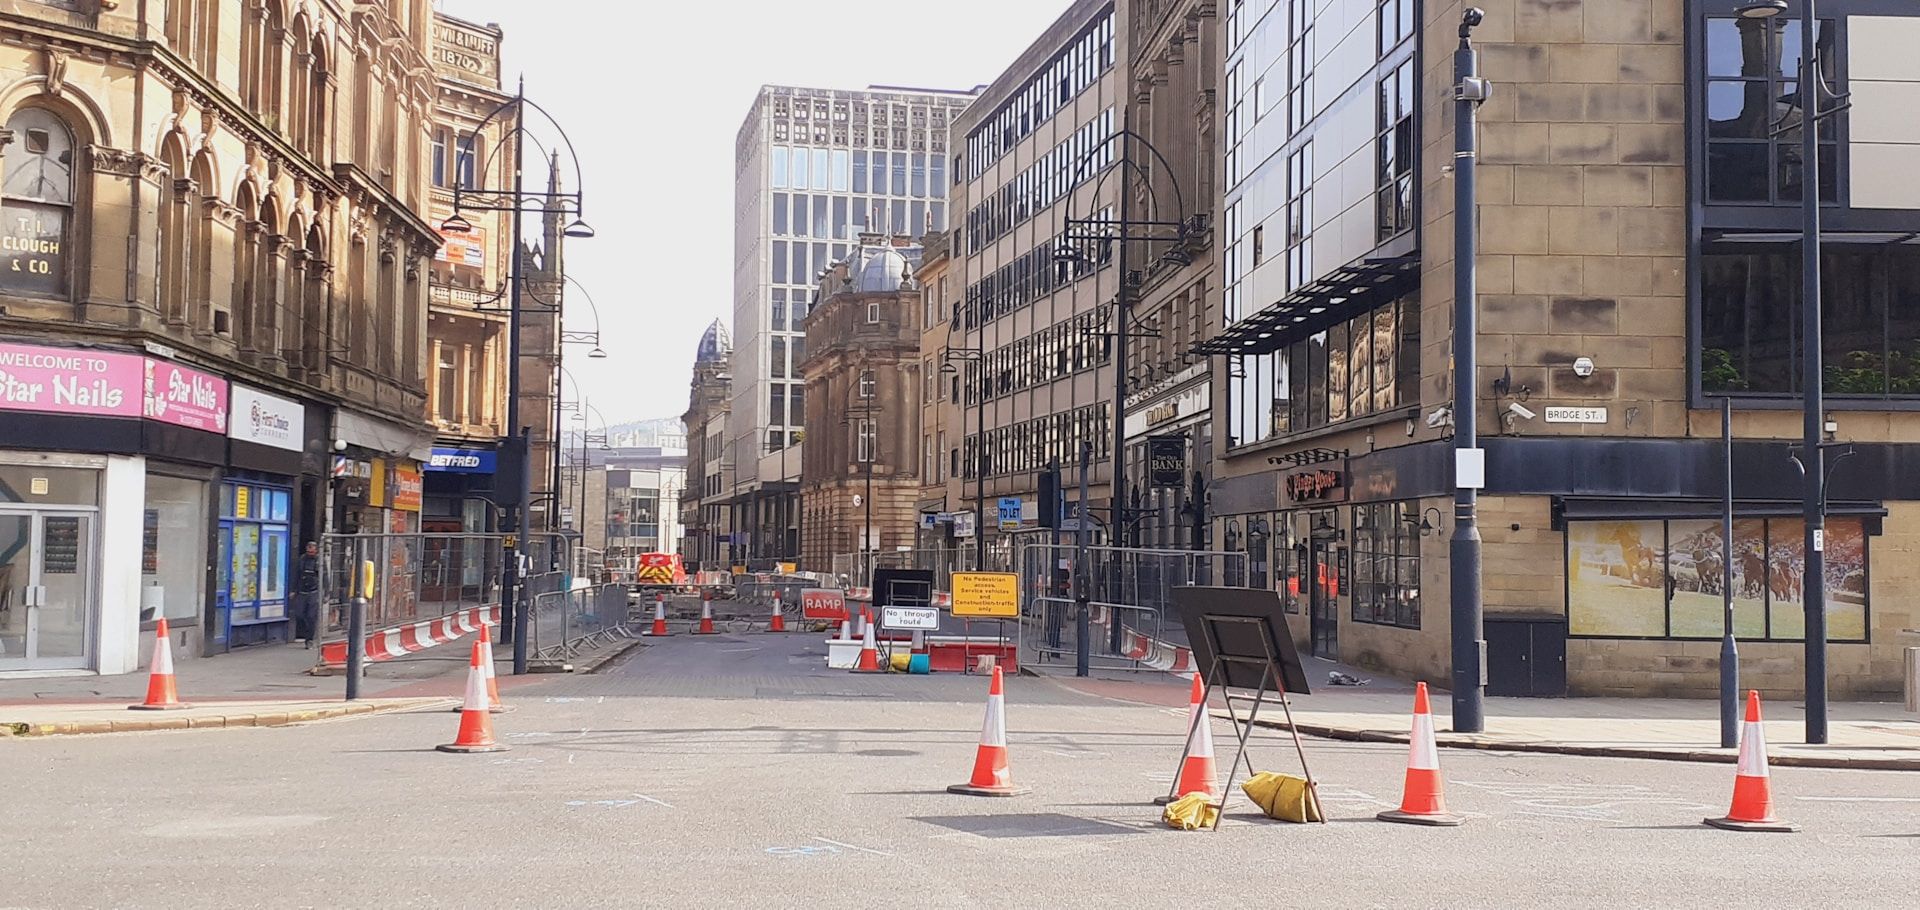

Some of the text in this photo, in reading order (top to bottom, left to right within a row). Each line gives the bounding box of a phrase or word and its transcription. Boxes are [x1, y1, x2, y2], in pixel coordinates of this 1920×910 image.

[2, 235, 60, 254] CLOUGH
[11, 258, 52, 274] & CO.
[0, 351, 107, 373] WELCOME TO
[52, 374, 123, 408] Nails
[168, 368, 217, 410] Star Nails
[1547, 410, 1580, 419] BRIDGE
[430, 454, 480, 468] BETFRED
[1151, 460, 1184, 470] BANK
[999, 507, 1008, 519] TO
[1009, 507, 1020, 519] LET
[806, 599, 842, 610] RAMP
[904, 610, 935, 619] through
